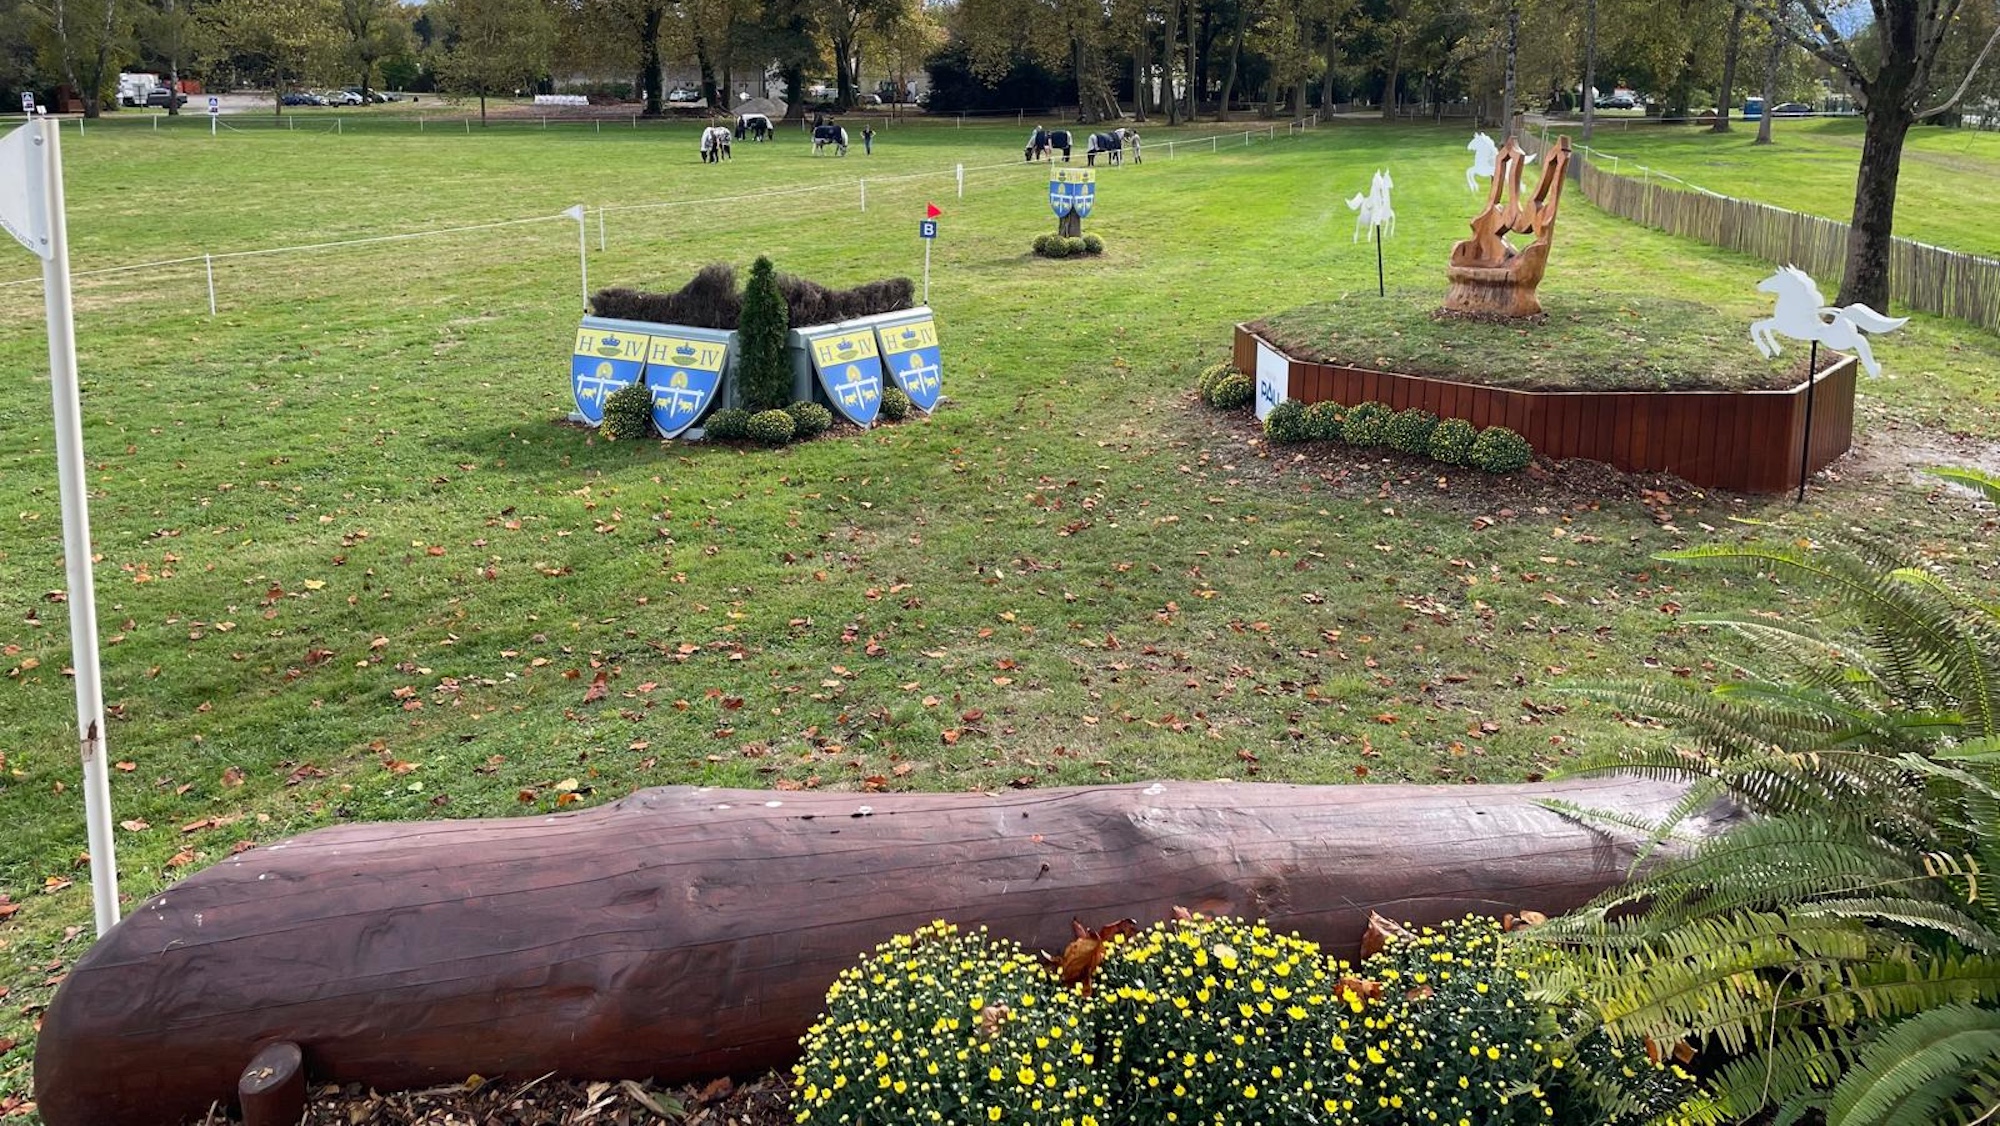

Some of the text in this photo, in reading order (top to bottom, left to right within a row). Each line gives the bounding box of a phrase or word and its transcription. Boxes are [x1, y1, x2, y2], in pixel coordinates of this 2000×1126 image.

[924, 223, 934, 236] B
[579, 336, 643, 356] H IV
[819, 336, 871, 363] H IV
[884, 327, 933, 351] H IV
[652, 344, 719, 366] H IV
